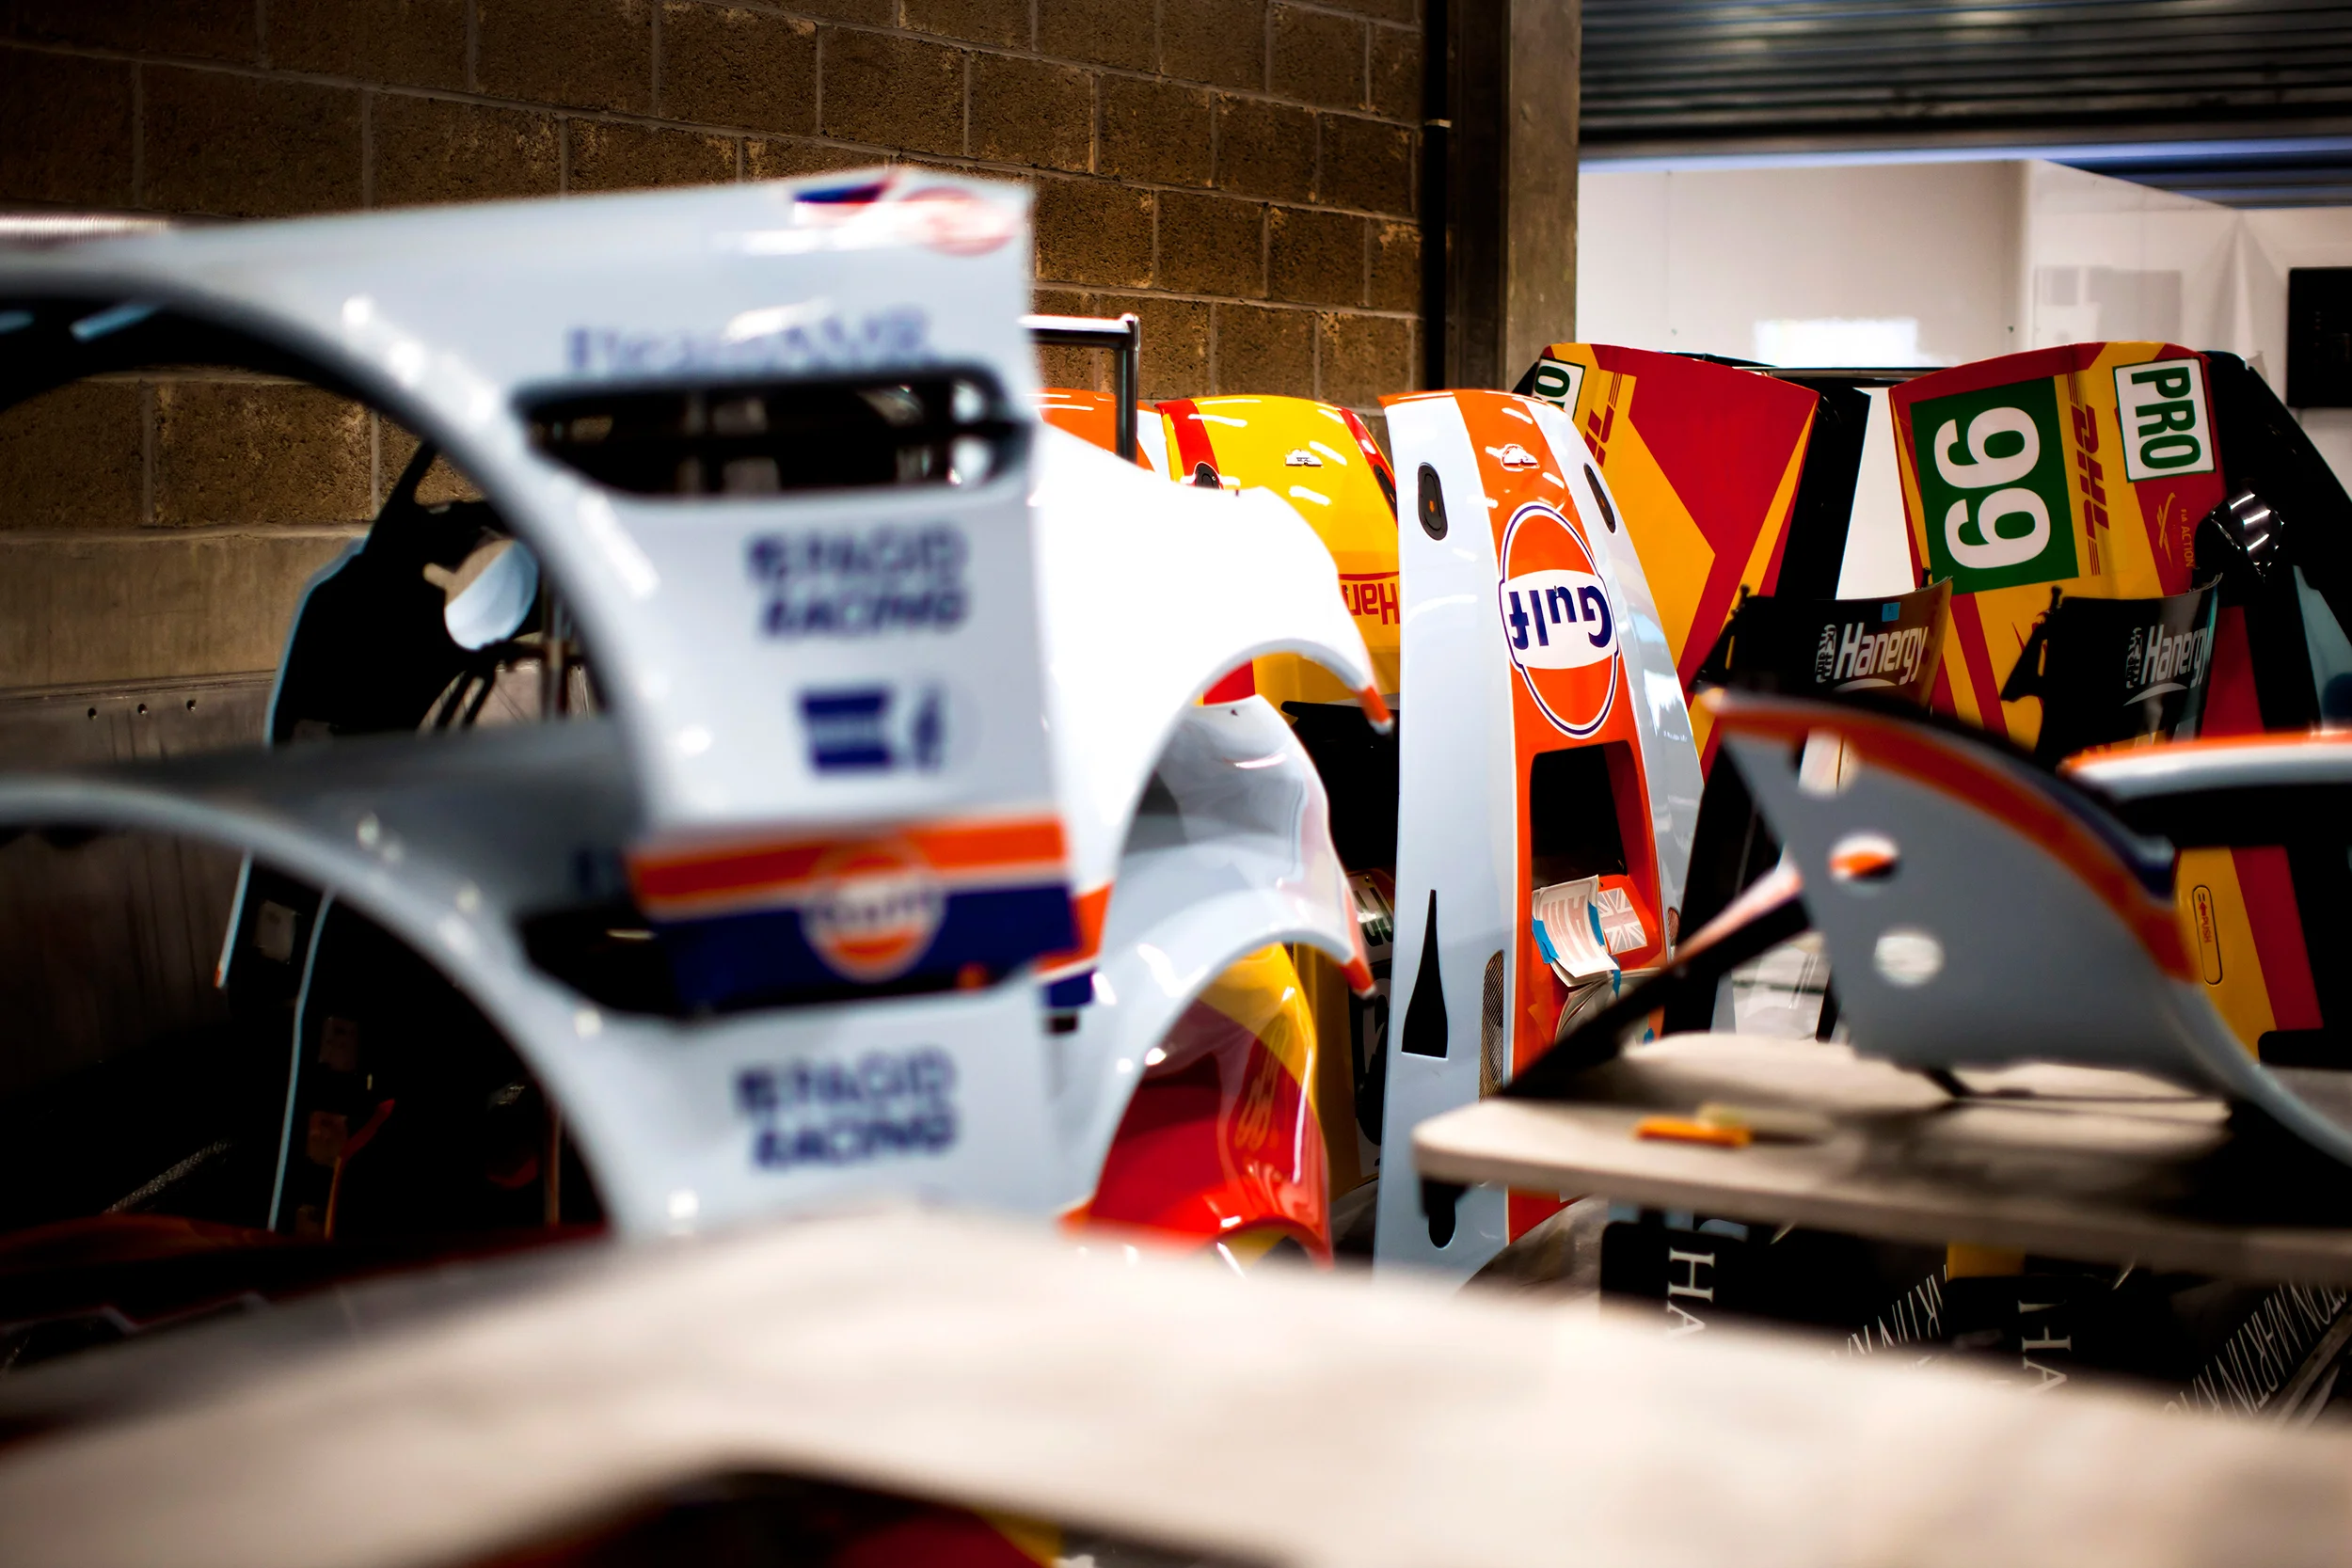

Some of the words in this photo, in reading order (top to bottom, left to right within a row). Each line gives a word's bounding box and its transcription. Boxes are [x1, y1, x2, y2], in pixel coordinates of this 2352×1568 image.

[2131, 366, 2201, 469] PRO
[1933, 406, 2051, 569] 99
[2070, 403, 2110, 541] DHL
[2181, 525, 2195, 568] ACTION
[1508, 585, 1613, 650] Gulf
[1833, 622, 1930, 685] Hanergy
[2140, 624, 2209, 689] Hanergy
[2201, 915, 2213, 943] PUSH
